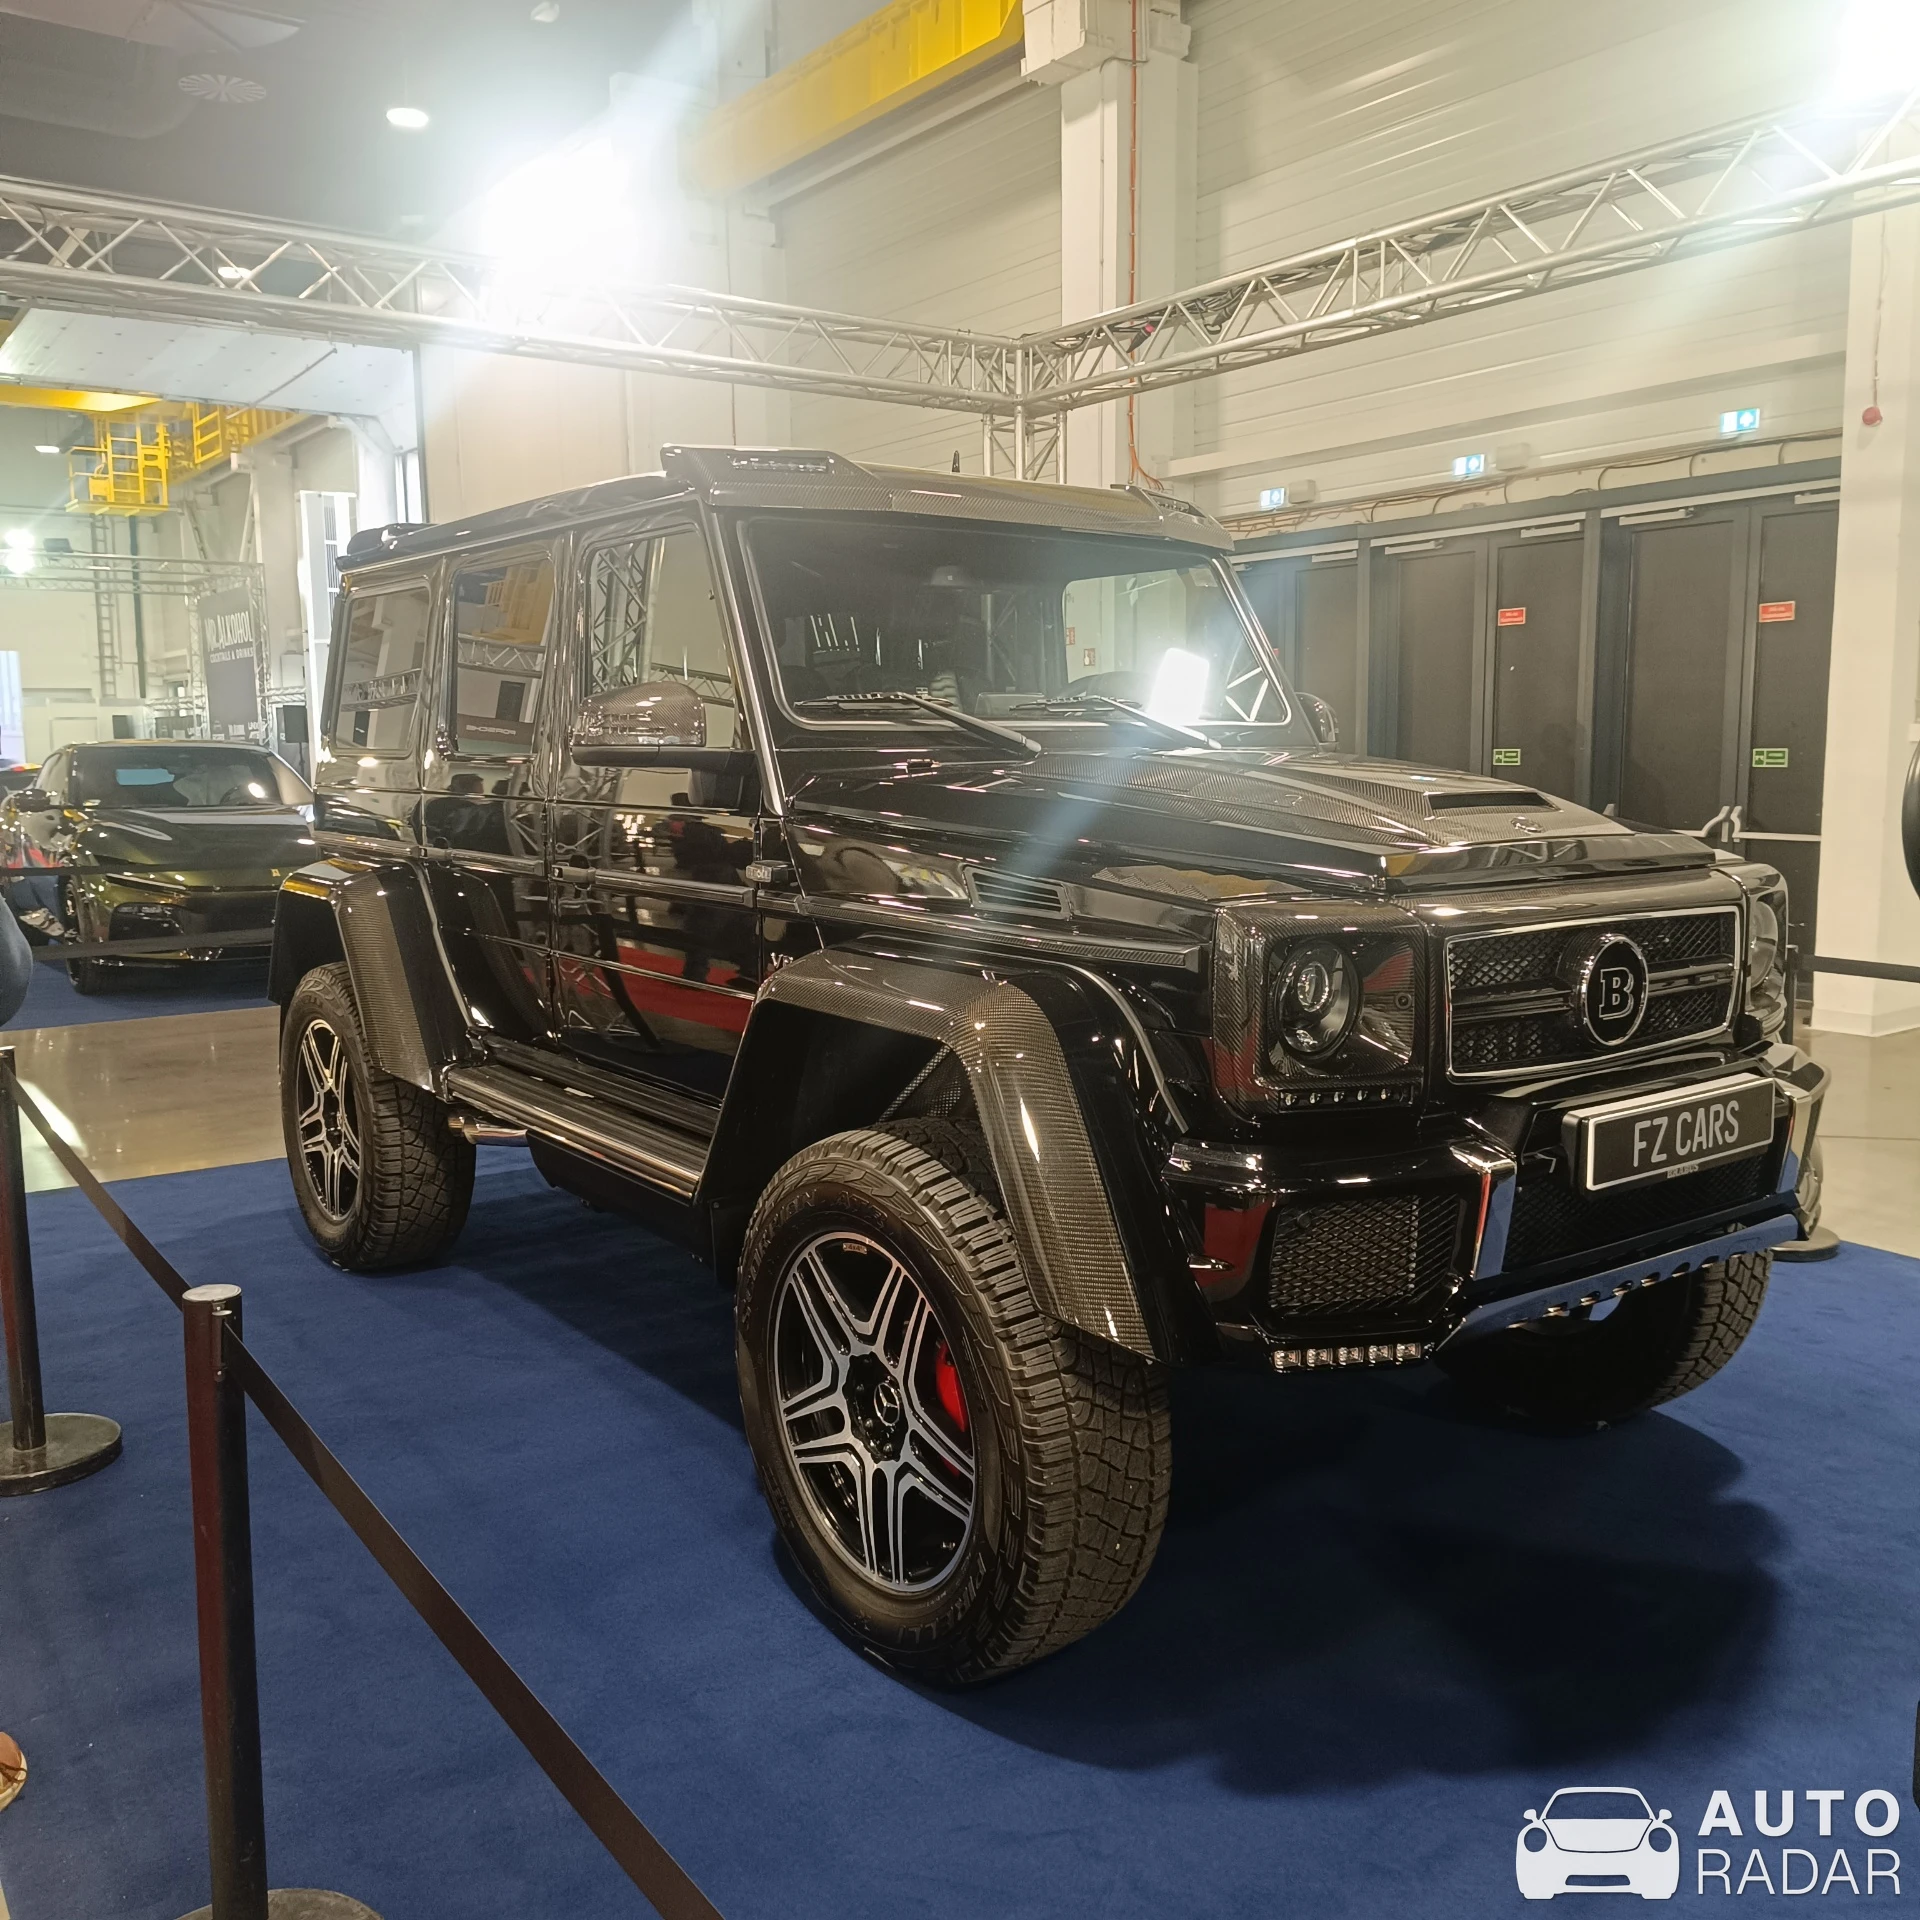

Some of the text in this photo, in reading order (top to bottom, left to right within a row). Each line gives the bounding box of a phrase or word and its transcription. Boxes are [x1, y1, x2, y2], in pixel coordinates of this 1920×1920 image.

[1599, 967, 1634, 1020] B
[1633, 1100, 1739, 1168] FZ CARS
